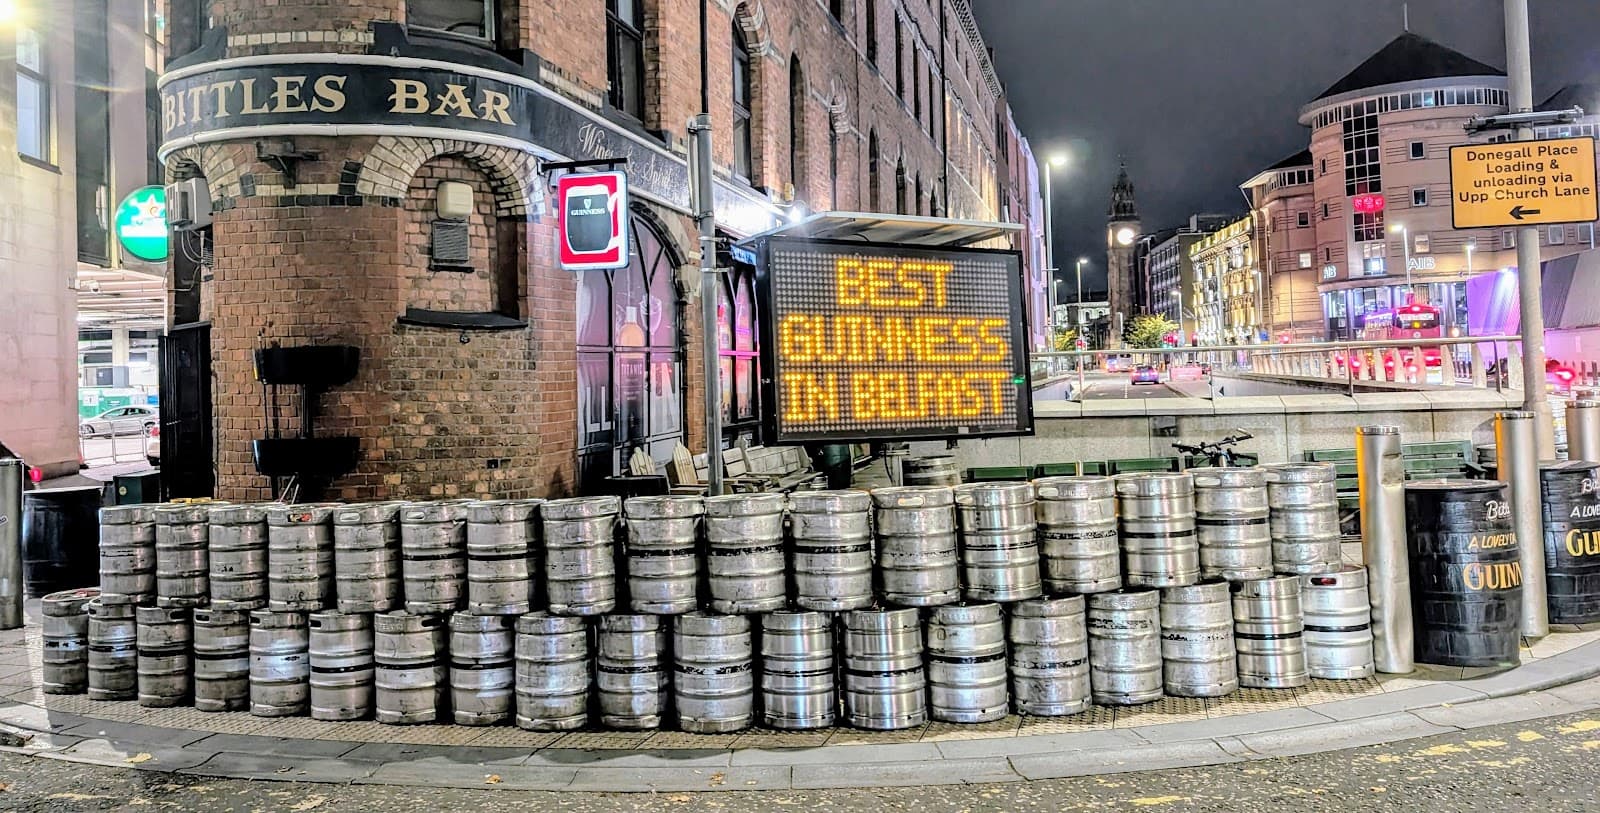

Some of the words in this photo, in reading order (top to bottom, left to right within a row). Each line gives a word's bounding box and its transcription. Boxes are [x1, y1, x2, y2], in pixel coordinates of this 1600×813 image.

[165, 74, 348, 133] BITTLES
[387, 78, 517, 126] BAR
[1466, 146, 1532, 162] Donegall
[1538, 145, 1578, 157] Place
[1486, 161, 1544, 174] Loading
[1549, 159, 1559, 170] &
[1473, 174, 1546, 188] unloading
[1551, 172, 1573, 183] via
[1459, 191, 1489, 204] Upp
[1494, 187, 1548, 200] Church
[1554, 186, 1590, 197] Lane
[571, 208, 605, 216] GUINNESS
[1408, 256, 1435, 270] AIB
[836, 259, 953, 308] BEST
[779, 313, 1009, 363] GUINNESS
[783, 371, 839, 421] IN
[851, 371, 1009, 419] BELFAST
[1570, 505, 1581, 518] A
[1582, 503, 1600, 517] LOVE
[1468, 535, 1479, 549] A
[1463, 560, 1523, 590] GUINN
